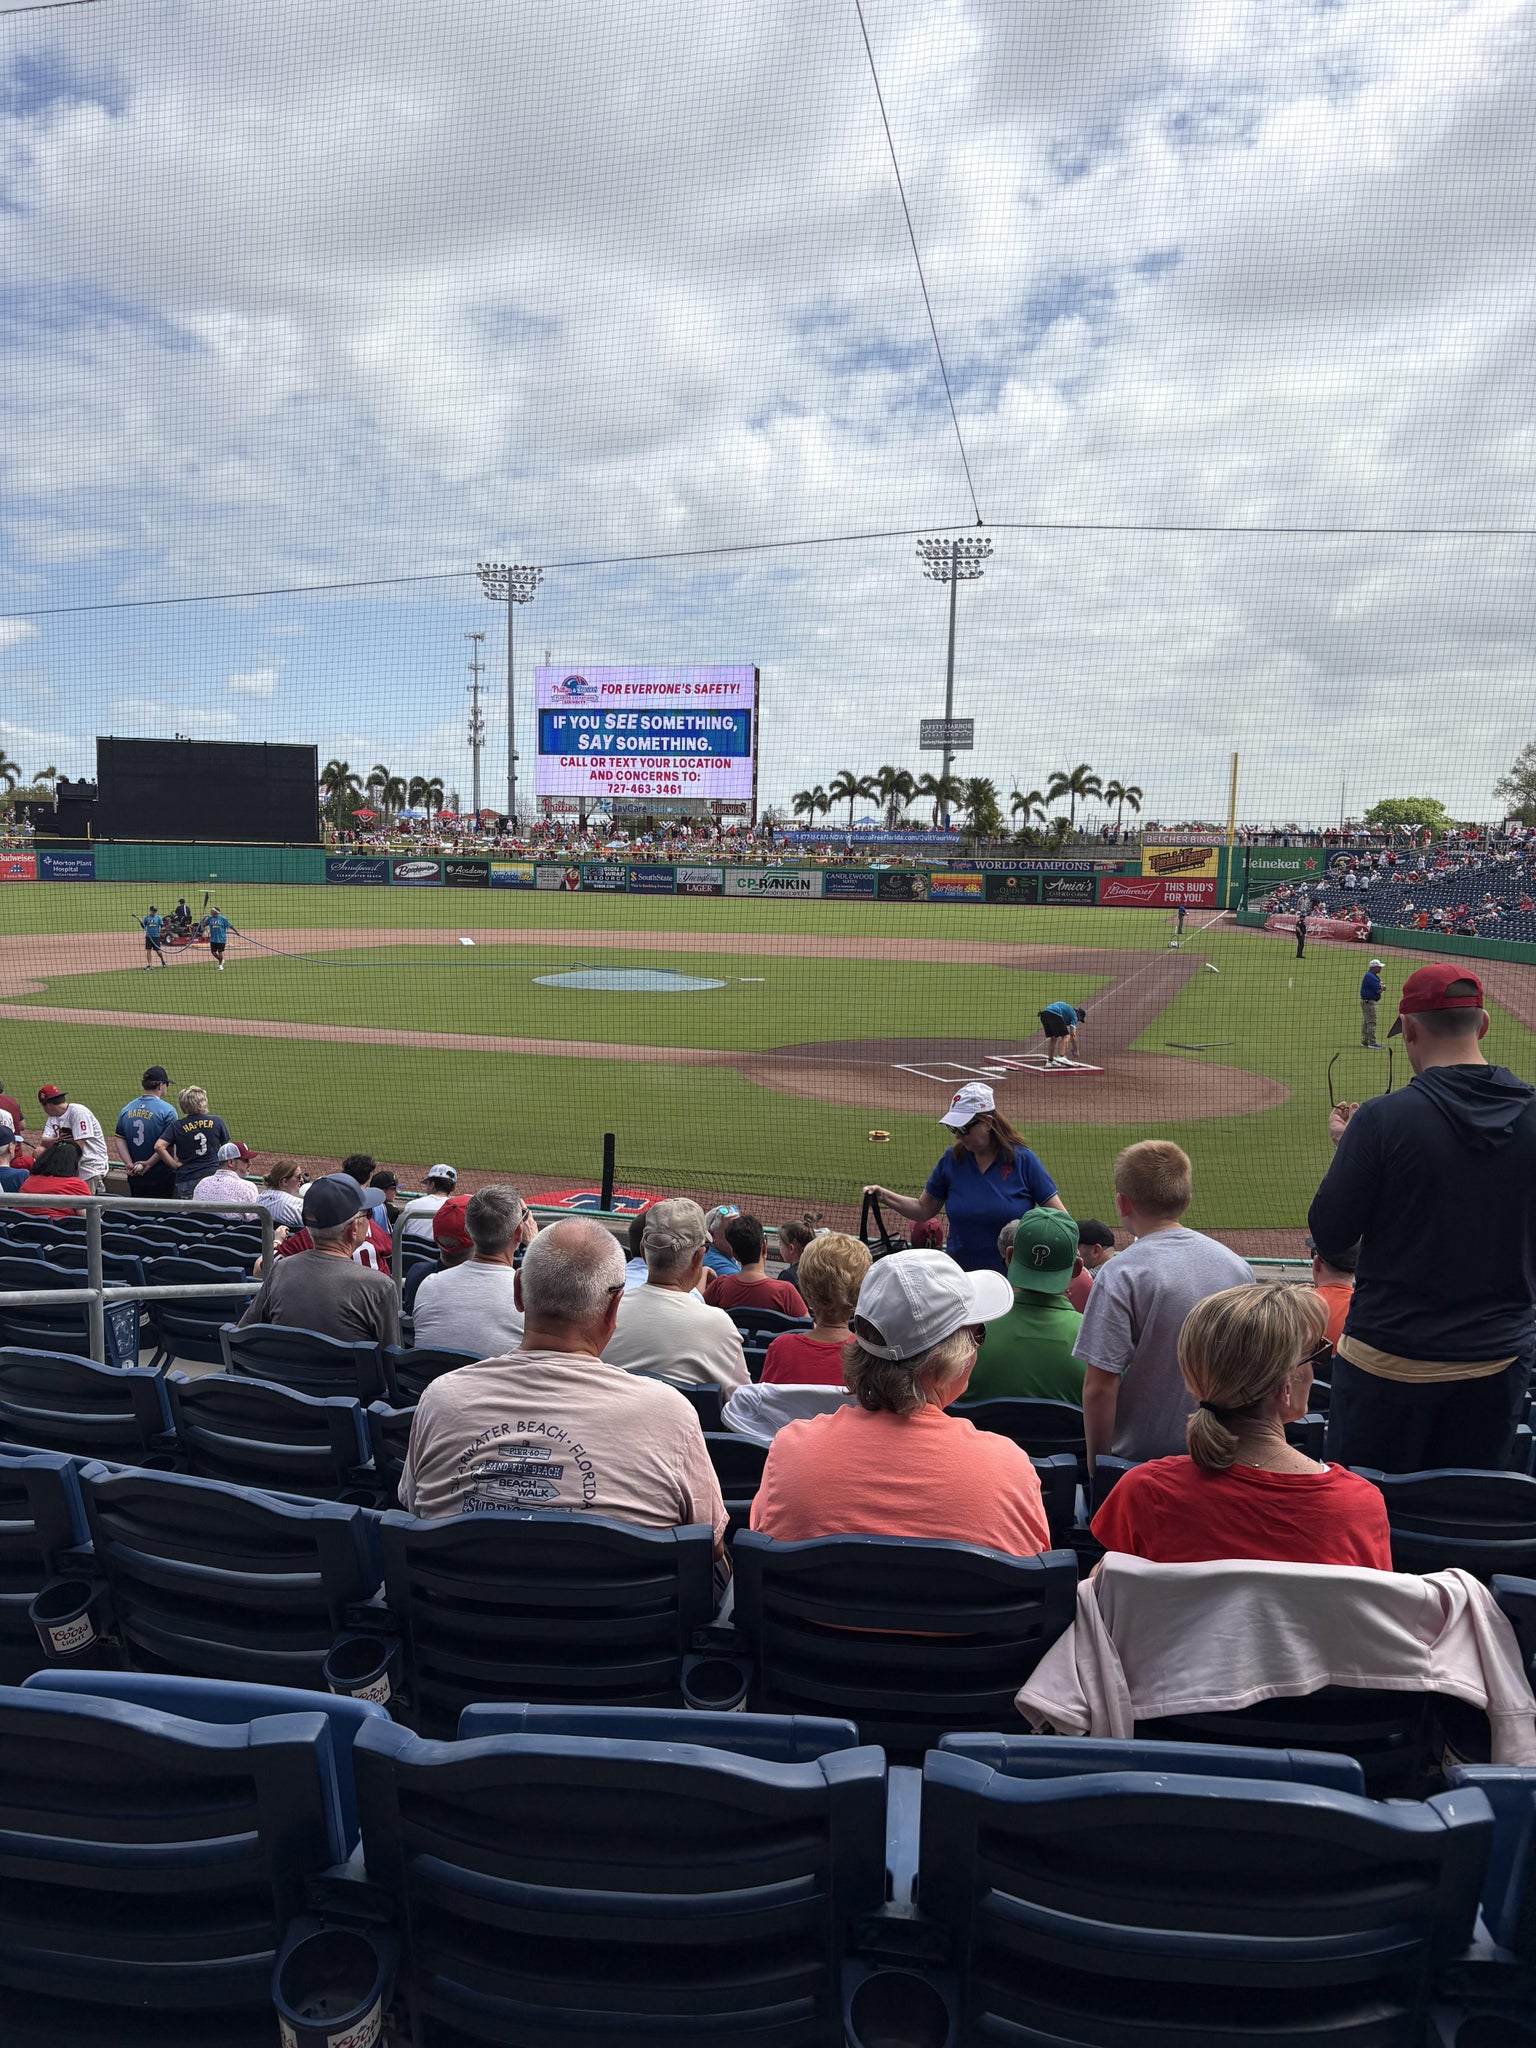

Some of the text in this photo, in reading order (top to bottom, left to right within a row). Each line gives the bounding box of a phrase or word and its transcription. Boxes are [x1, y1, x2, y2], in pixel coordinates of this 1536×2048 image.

[601, 683, 741, 695] FOR EVERYONE'S SAFETY!
[553, 713, 738, 732] IF YOU SEE SOMETHING,
[578, 735, 712, 751] SAY SOMETHING.
[560, 757, 731, 769] CALL OR TEXT YOUR LOCATION
[589, 771, 701, 782] AND CONCERNS TO:
[607, 783, 682, 795] 727-463-3461
[542, 798, 578, 813] Phillies
[612, 803, 688, 814] BayCare Ballpark
[1146, 835, 1221, 844] BELCHER BINGO
[455, 865, 488, 877] Academy
[975, 860, 1017, 870] WORLD
[1018, 861, 1090, 871] CHAMPIONS
[638, 872, 673, 881] SouthState
[826, 872, 875, 880] CANDLEWOOD
[686, 883, 713, 892] LAGER
[1044, 877, 1094, 892] Amici's
[1164, 882, 1214, 892] THIS BUD'S
[1108, 885, 1152, 896] Budweiser
[1164, 893, 1204, 903] FOR YOU.
[127, 1109, 154, 1120] HARPER
[80, 1121, 87, 1131] 6
[182, 1120, 214, 1133] HARPER
[133, 1119, 145, 1147] 3
[194, 1132, 208, 1156] 3
[509, 1448, 528, 1456] PIER
[451, 1421, 597, 1511] CLARWATER BEACH FLORIDA
[486, 1462, 561, 1477] SAND KEY BEACH
[499, 1479, 537, 1489] BEACH
[517, 1488, 549, 1498] WALK
[52, 1623, 89, 1641] Coors
[61, 1634, 85, 1647] LIGHT
